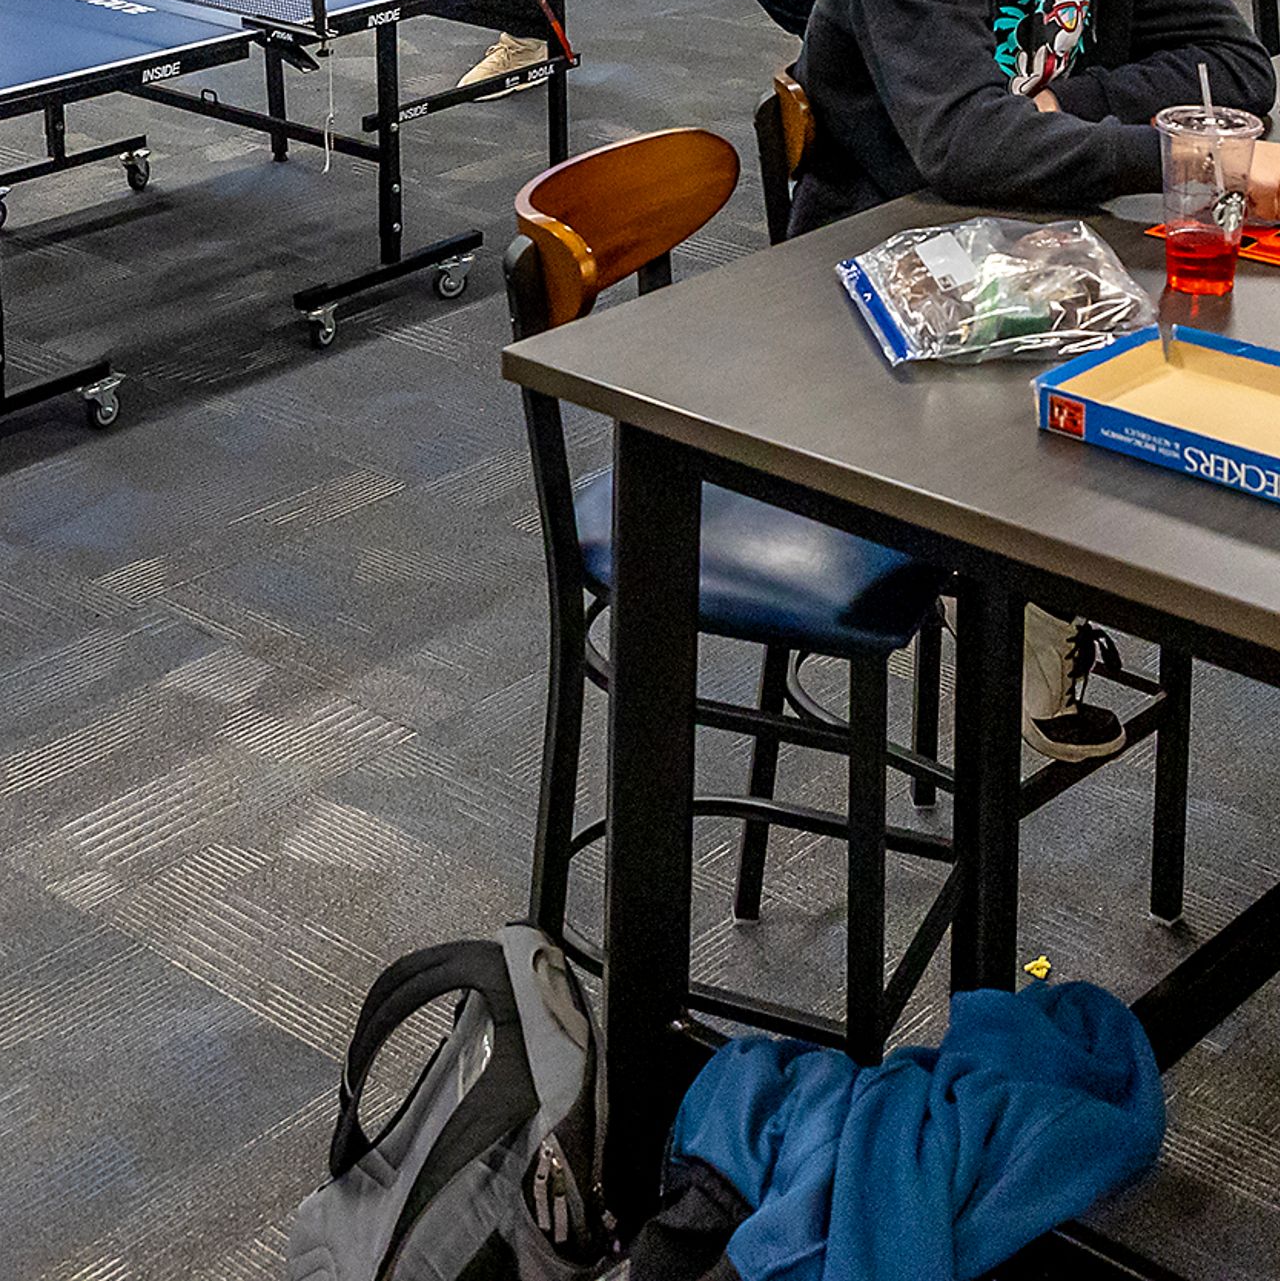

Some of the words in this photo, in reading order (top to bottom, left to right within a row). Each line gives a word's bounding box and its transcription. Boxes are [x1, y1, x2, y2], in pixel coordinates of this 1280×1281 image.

[367, 7, 401, 27] INSIDE
[141, 61, 182, 83] INSIDE
[526, 63, 556, 81] JOOLA
[398, 102, 429, 121] INSIDE
